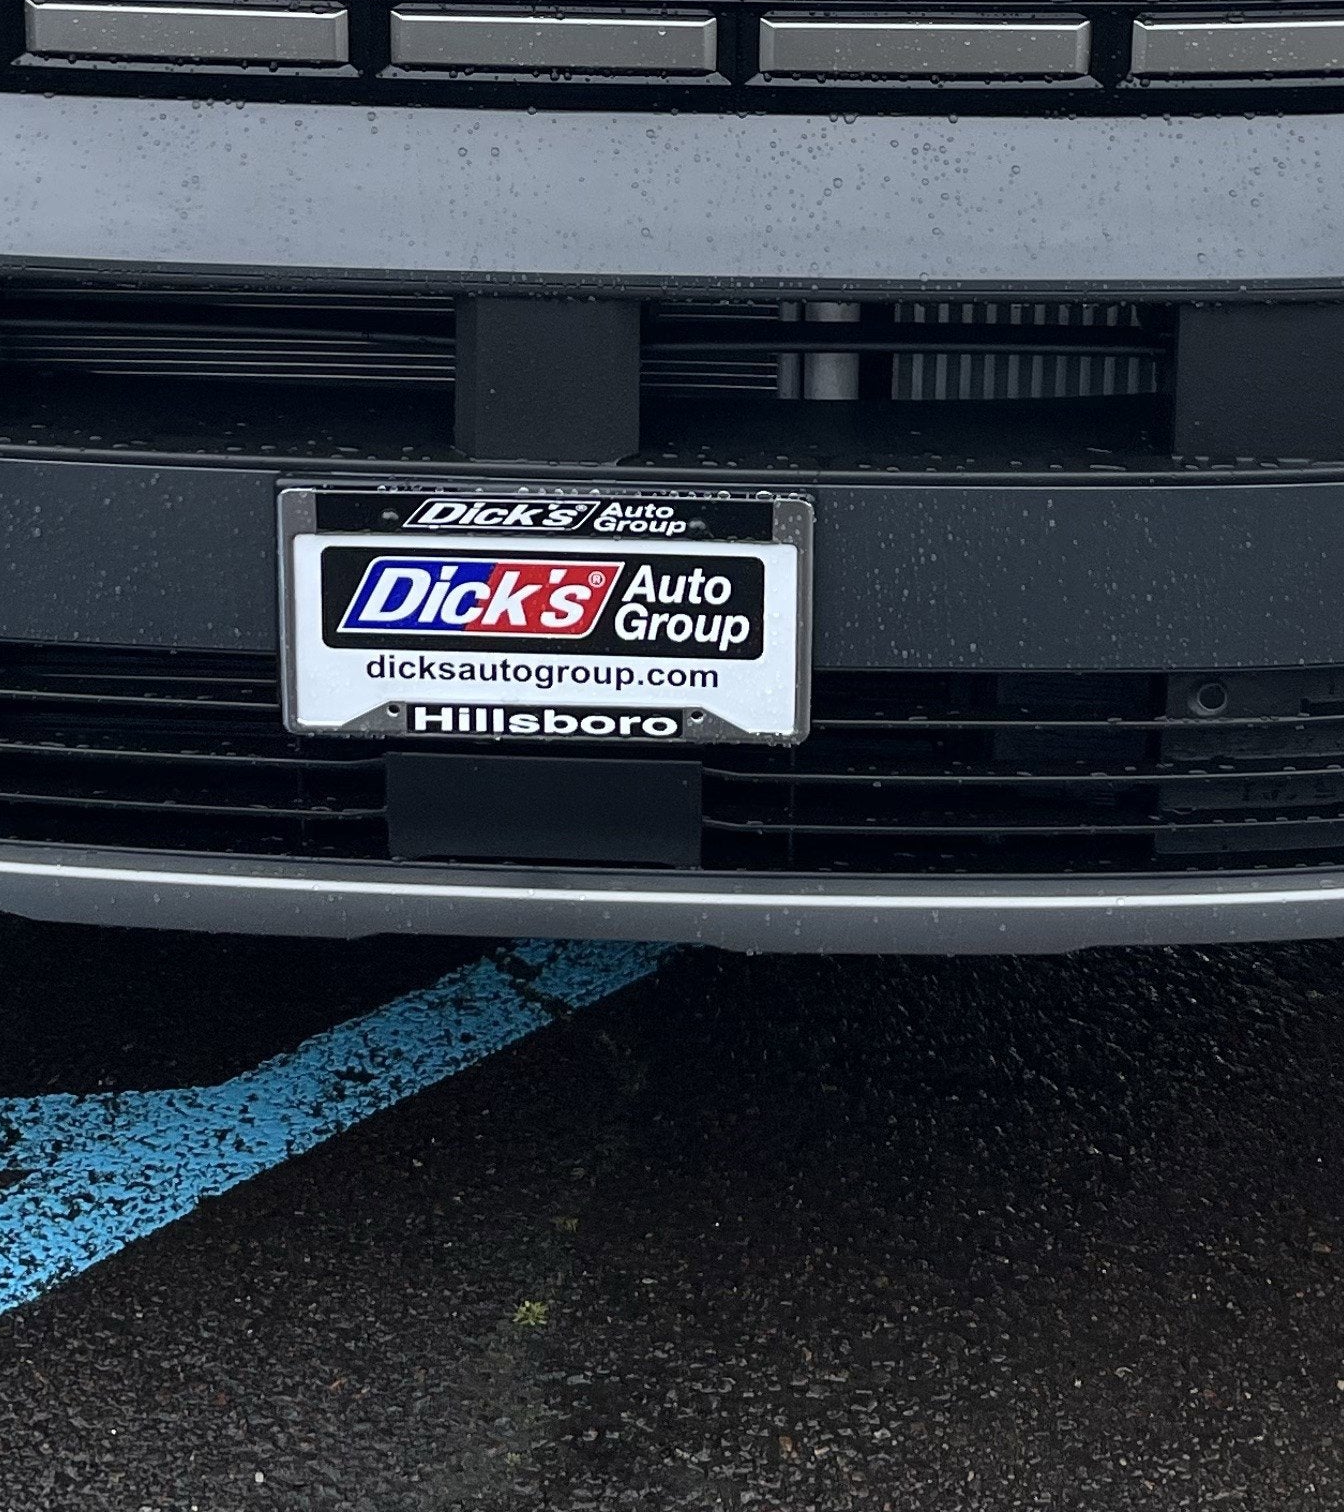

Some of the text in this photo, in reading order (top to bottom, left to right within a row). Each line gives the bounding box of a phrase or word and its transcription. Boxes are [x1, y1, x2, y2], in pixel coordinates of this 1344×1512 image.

[417, 502, 579, 527] Dick's
[593, 517, 687, 537] Group
[599, 502, 675, 519] Auto
[357, 565, 593, 628] Dick's
[621, 564, 732, 605] Auto
[614, 602, 750, 652] Group
[366, 654, 719, 691] dicksautogroup.com
[413, 706, 679, 737] Hillsboro
